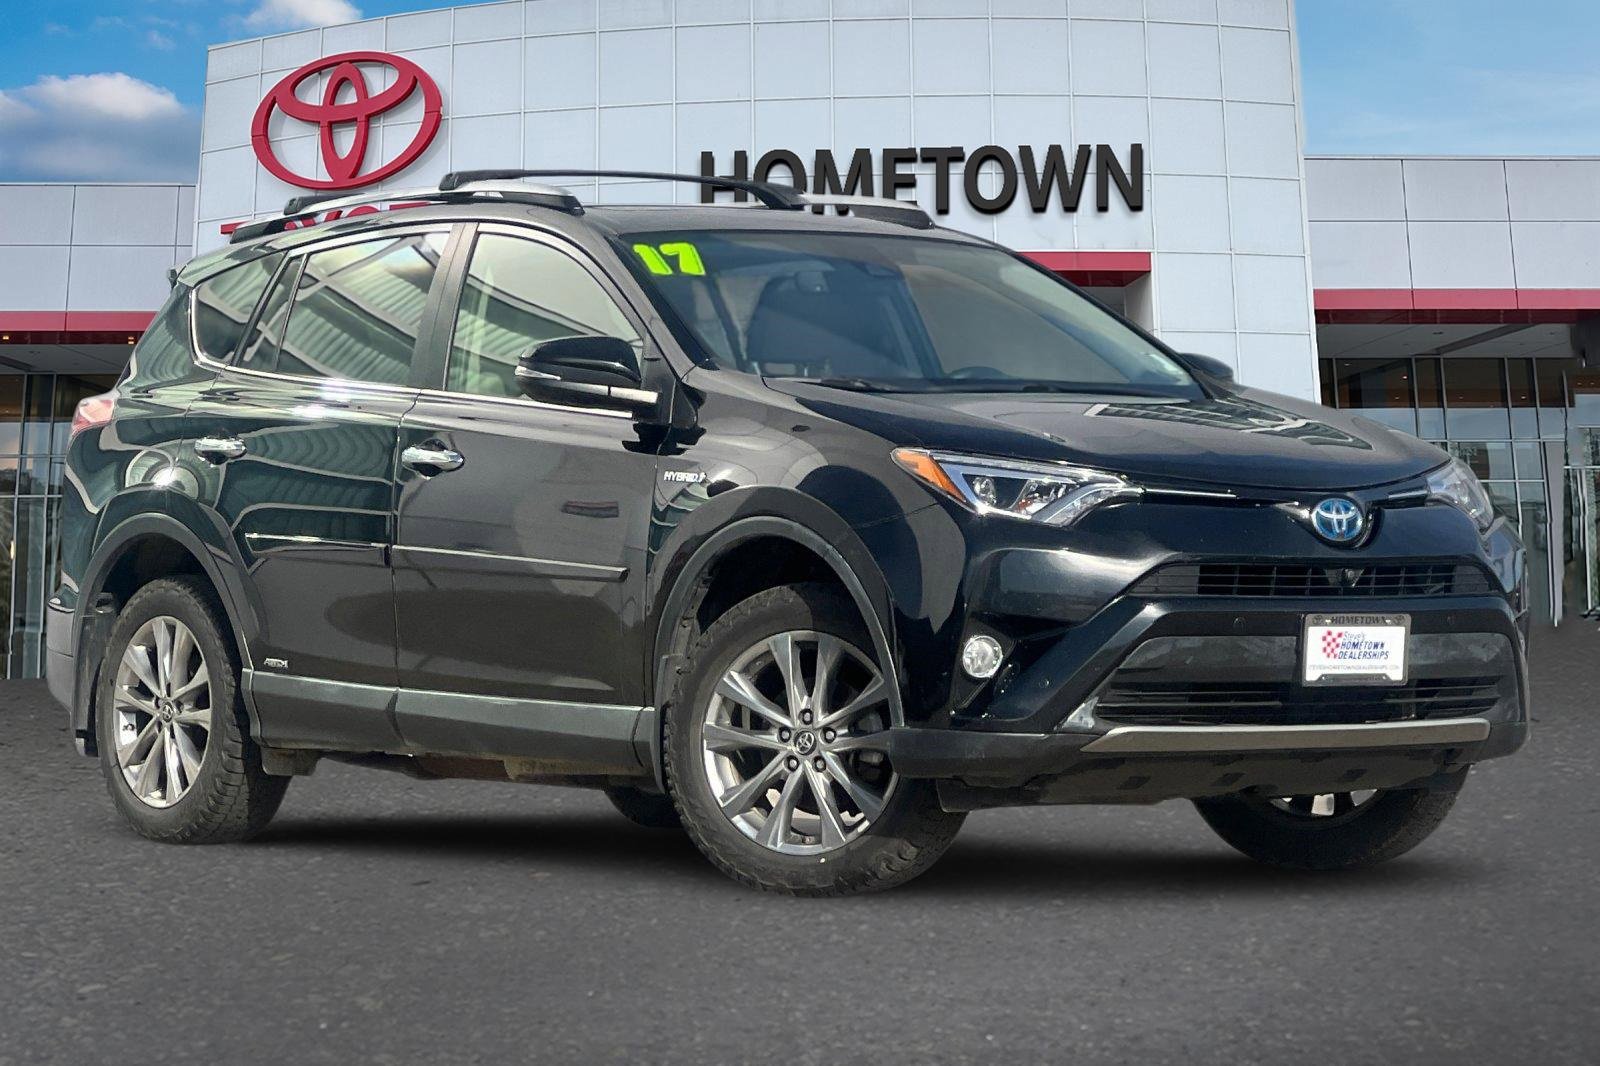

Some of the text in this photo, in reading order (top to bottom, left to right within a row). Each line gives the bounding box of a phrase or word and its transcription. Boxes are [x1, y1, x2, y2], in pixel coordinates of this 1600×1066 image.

[700, 143, 1144, 214] HOMETOWN
[633, 243, 706, 275] 17
[664, 471, 699, 482] HYBRID
[1331, 615, 1387, 624] HOMETOWN
[1341, 641, 1385, 649] HOMETOWN
[1338, 651, 1389, 659] DEALERSHIPS
